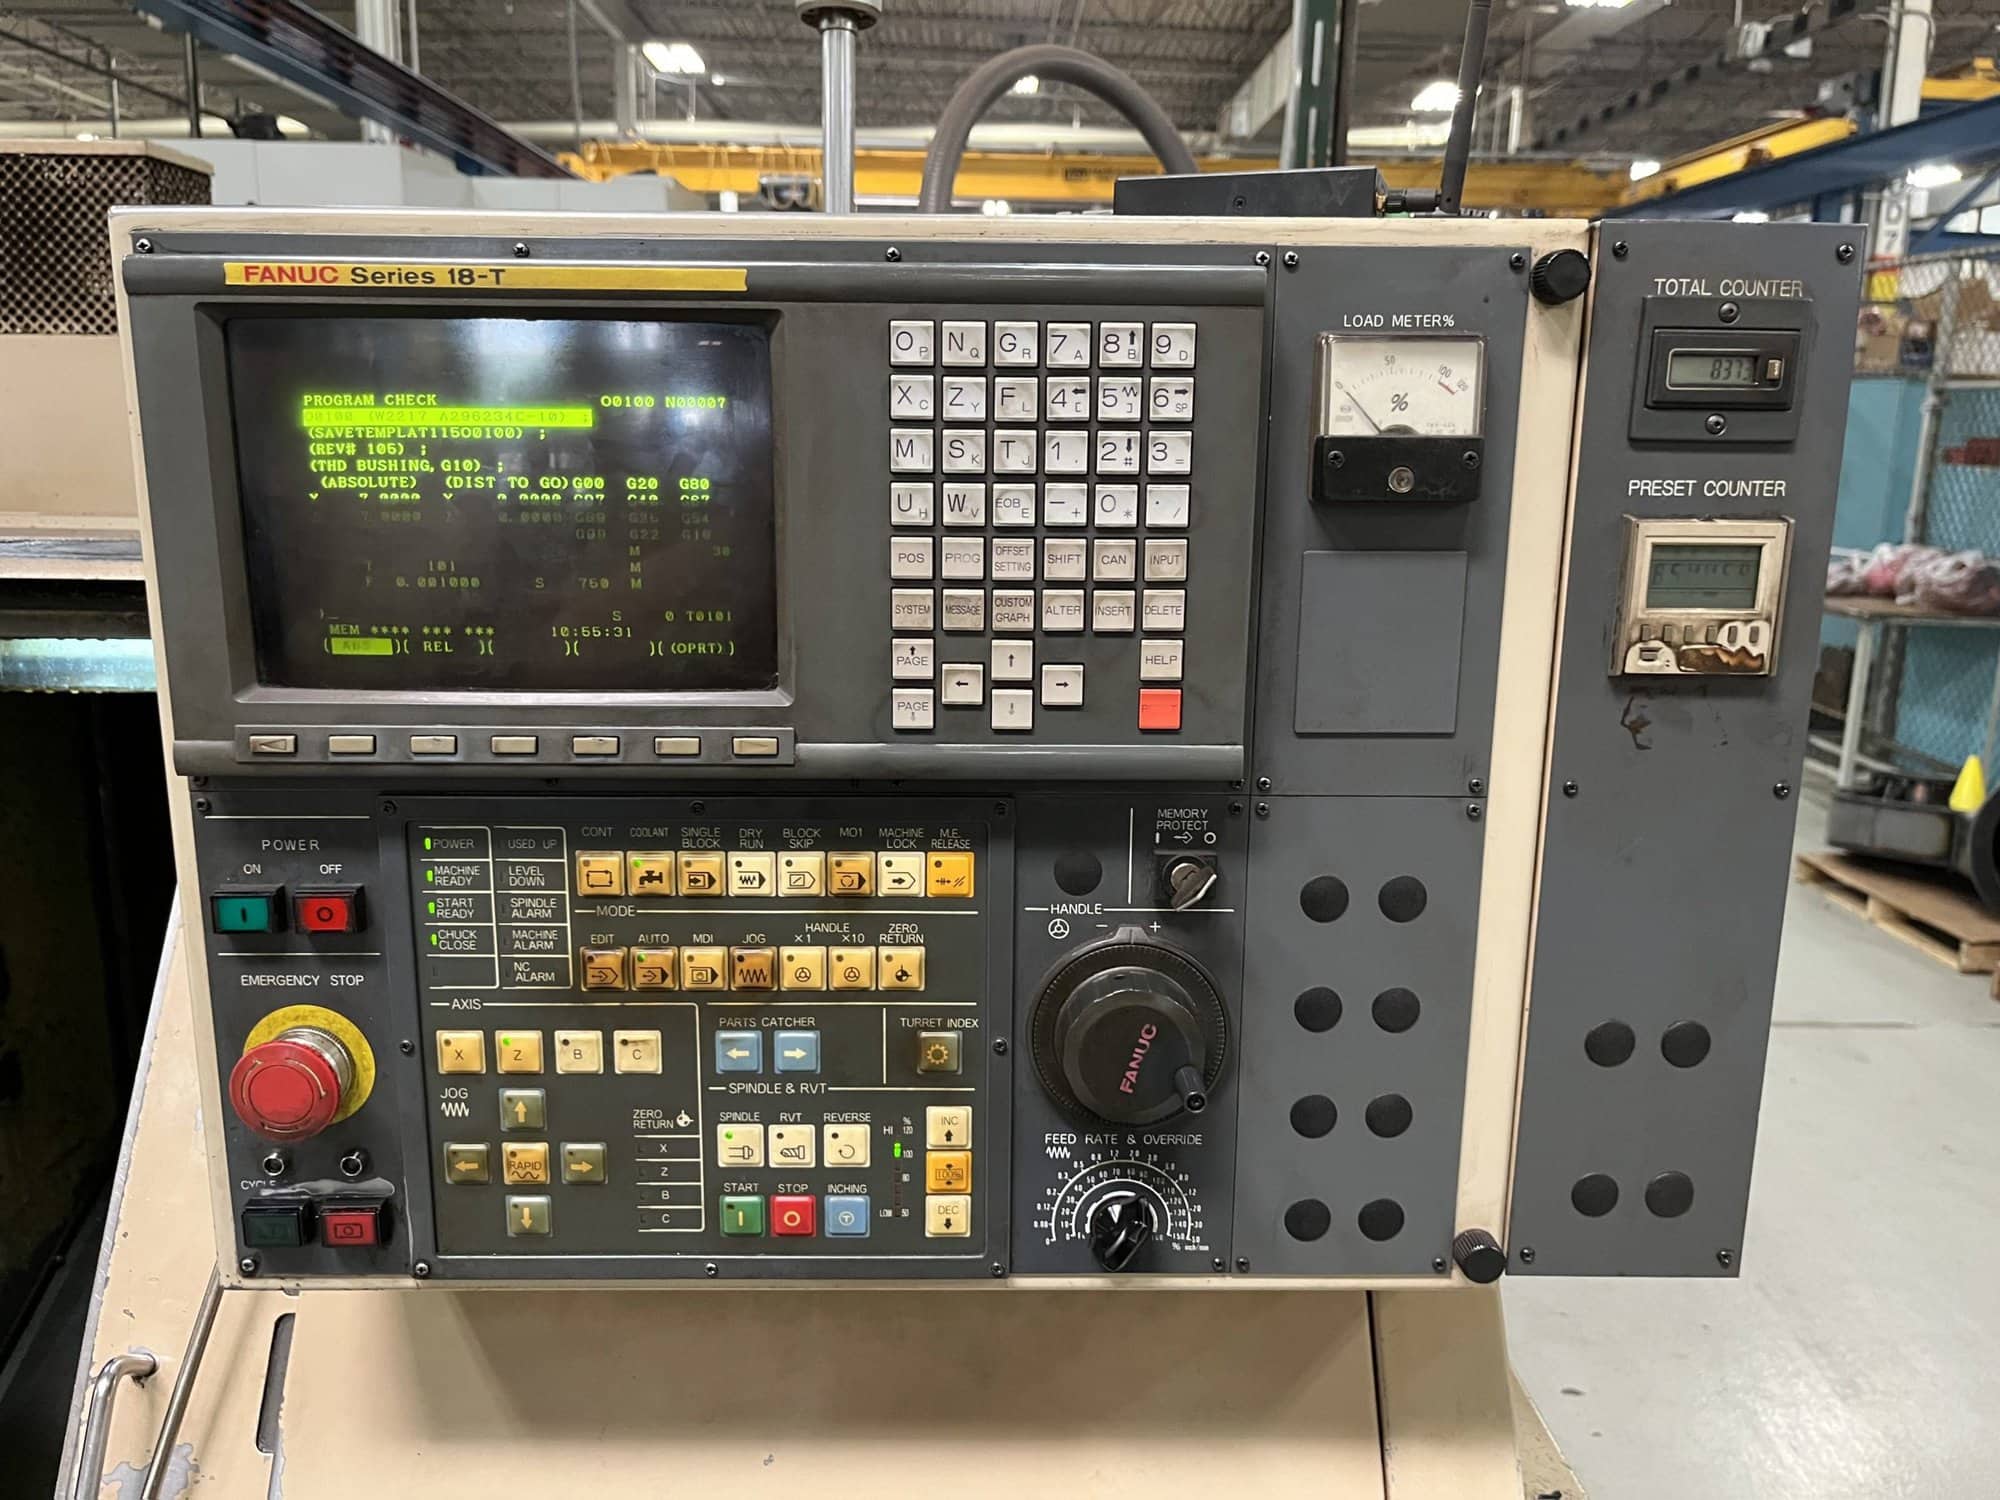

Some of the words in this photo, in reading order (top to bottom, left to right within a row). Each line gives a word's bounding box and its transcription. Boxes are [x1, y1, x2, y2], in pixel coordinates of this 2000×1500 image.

[244, 265, 339, 284] FANUC
[351, 267, 435, 284] Series
[448, 268, 505, 285] 18-T
[1654, 279, 1712, 296] TOTAL
[1720, 280, 1803, 297] COUNTER
[1344, 315, 1383, 327] LOAD
[949, 332, 963, 351] N
[1000, 333, 1017, 352] G
[1051, 334, 1067, 354] 7
[1104, 334, 1119, 353] 8
[1156, 335, 1171, 354] 9
[1385, 355, 1395, 365] 50
[304, 395, 374, 406] PROGRAM
[385, 396, 436, 406] CHECK
[1051, 389, 1067, 407] 4
[1102, 389, 1117, 407] 5
[1391, 393, 1408, 412] %
[1176, 403, 1187, 413] SP
[896, 439, 913, 458] M
[321, 476, 417, 488] (ABSOLUTE)
[508, 477, 528, 488] TO
[627, 478, 658, 490] G20
[679, 478, 709, 490] G80
[1628, 480, 1696, 496] PRESET
[1704, 481, 1786, 496] COUNTER
[996, 498, 1020, 508] EOB
[996, 546, 1029, 556] OFFSET
[899, 553, 924, 563] POS
[945, 553, 980, 563] PROG
[1048, 554, 1080, 564] SHIFT
[1101, 555, 1127, 564] CAN
[1151, 555, 1180, 565] INPUT
[994, 562, 1031, 572] SETTING
[995, 598, 1032, 607] CUSTOM
[896, 605, 930, 614] SYSTEM
[946, 606, 981, 615] MESSAGE
[1045, 606, 1081, 615] ALTER
[1095, 606, 1131, 616] INSERT
[1145, 606, 1182, 615] DELETE
[996, 613, 1030, 622] GRAPH
[329, 625, 360, 634] MEM
[552, 627, 632, 638] 10:55:31
[424, 641, 453, 652] REL
[897, 657, 928, 665] PAGE
[1146, 656, 1177, 665] HELP
[898, 702, 928, 711] PAGE
[1158, 809, 1208, 819] MEMORY
[1157, 821, 1208, 830] PROTECT
[581, 827, 613, 837] CONT
[630, 828, 668, 837] COOLANT
[681, 827, 721, 837] SINGLE
[740, 829, 763, 838] DRY
[783, 828, 821, 838] BLOCK
[879, 828, 924, 838] MACHINE
[262, 840, 320, 850] POWER
[433, 839, 474, 848] POWER
[508, 840, 536, 848] USED
[543, 840, 557, 848] UP
[682, 839, 720, 848] BLOCK
[740, 840, 764, 848] RUN
[789, 839, 814, 848] SKIP
[887, 839, 916, 848] LOCK
[931, 840, 970, 848] RELEASE
[243, 864, 261, 874] ON
[320, 865, 342, 874] OFF
[434, 866, 480, 875] MACHINE
[509, 866, 544, 875] LEVEL
[435, 876, 472, 886] READY
[509, 877, 544, 886] DOWN
[437, 898, 474, 907] START
[511, 898, 557, 908] SPINDLE
[437, 909, 474, 918] READY
[512, 909, 552, 918] ALARM
[597, 906, 636, 916] MODE
[1050, 904, 1102, 914] HANDLE
[805, 923, 850, 932] HANDLE
[888, 924, 918, 933] ZERO
[438, 930, 477, 939] CHUCK
[513, 930, 558, 939] MACHINE
[591, 934, 614, 944] EDIT
[638, 934, 669, 943] AUTO
[693, 934, 713, 943] MDI
[742, 934, 766, 944] JOG
[880, 934, 924, 943] RETURN
[439, 941, 476, 950] CLOSE
[514, 941, 554, 950] ALARM
[514, 962, 530, 971] NC
[241, 975, 320, 985] EMERGENCY
[330, 975, 364, 985] STOP
[515, 973, 555, 982] ALARM
[452, 999, 481, 1009] AXIS
[719, 1018, 757, 1027] PARTS
[762, 1017, 816, 1026] CATCHER
[901, 1019, 942, 1027] TURRET
[947, 1019, 979, 1028] INDEX
[455, 1050, 464, 1060] X
[513, 1051, 522, 1060] Z
[1120, 1023, 1157, 1094] FANUC
[729, 1083, 781, 1093] SPINDLE
[786, 1084, 795, 1093] &
[800, 1084, 827, 1093] RVT
[440, 1088, 468, 1098] JOG
[633, 1110, 662, 1119] ZERO
[720, 1112, 760, 1121] SPINDLE
[780, 1113, 802, 1121] RVT
[824, 1113, 871, 1121] REVERSE
[633, 1120, 673, 1129] RETURN
[941, 1116, 959, 1125] INC
[883, 1126, 893, 1135] HI
[903, 1126, 913, 1134] 120
[1045, 1134, 1076, 1144] FEED
[1085, 1134, 1118, 1144] RATE
[1127, 1134, 1136, 1144] &
[1144, 1135, 1202, 1144] OVERRIDE
[903, 1150, 913, 1158] 100
[510, 1161, 542, 1170] RAPID
[724, 1184, 759, 1192] START
[778, 1184, 808, 1193] STOP
[828, 1184, 867, 1193] INCHING
[938, 1206, 959, 1214] DEC
